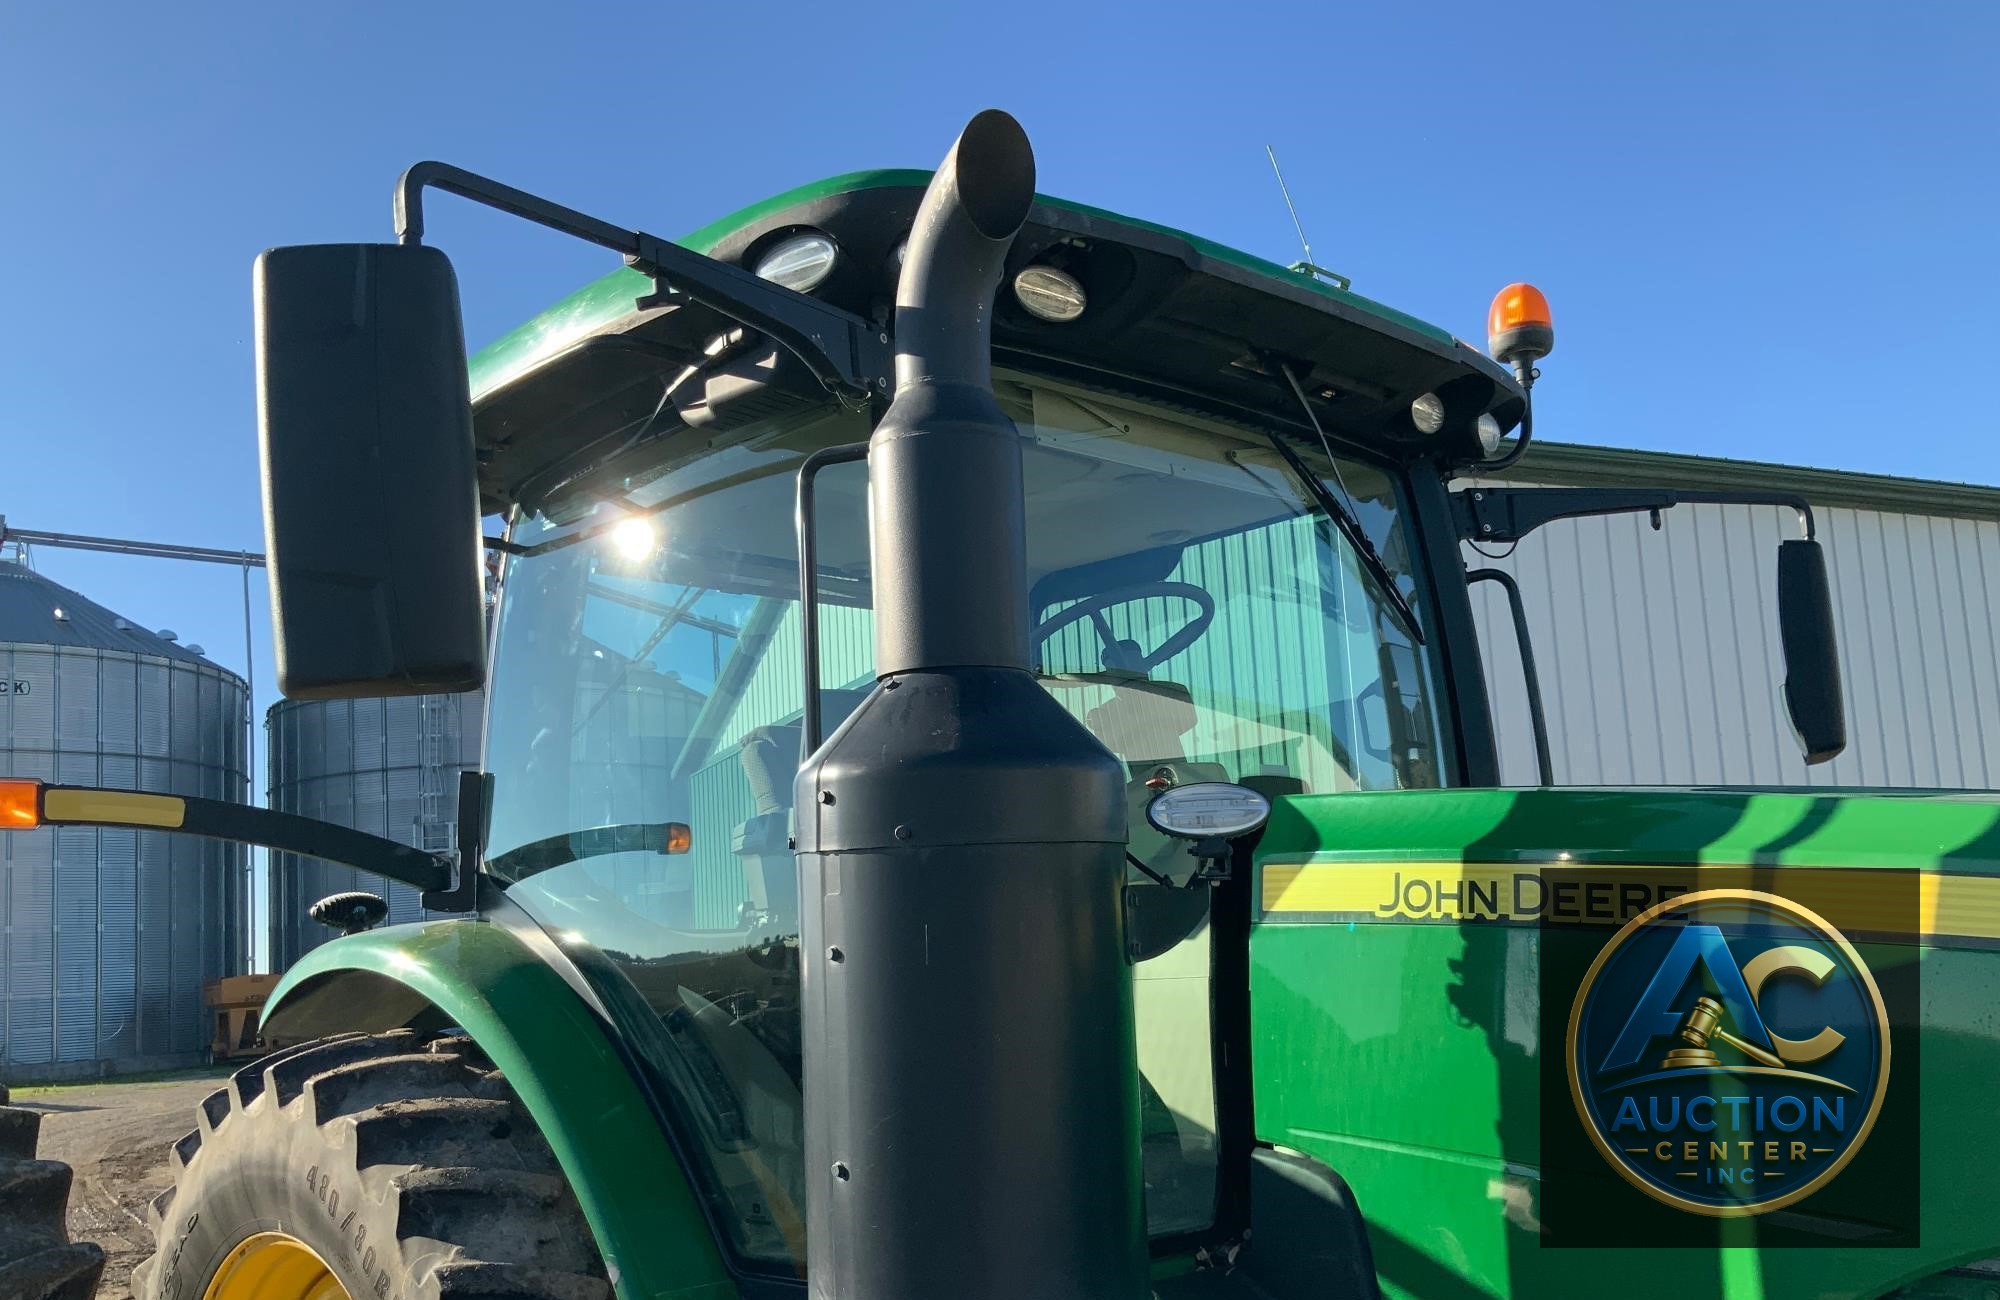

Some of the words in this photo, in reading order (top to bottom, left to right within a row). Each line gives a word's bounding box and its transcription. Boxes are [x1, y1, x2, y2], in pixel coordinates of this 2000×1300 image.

[1379, 871, 1498, 915] JOHN
[1512, 872, 1689, 922] DEERE
[306, 1165, 400, 1300] 480/80R
